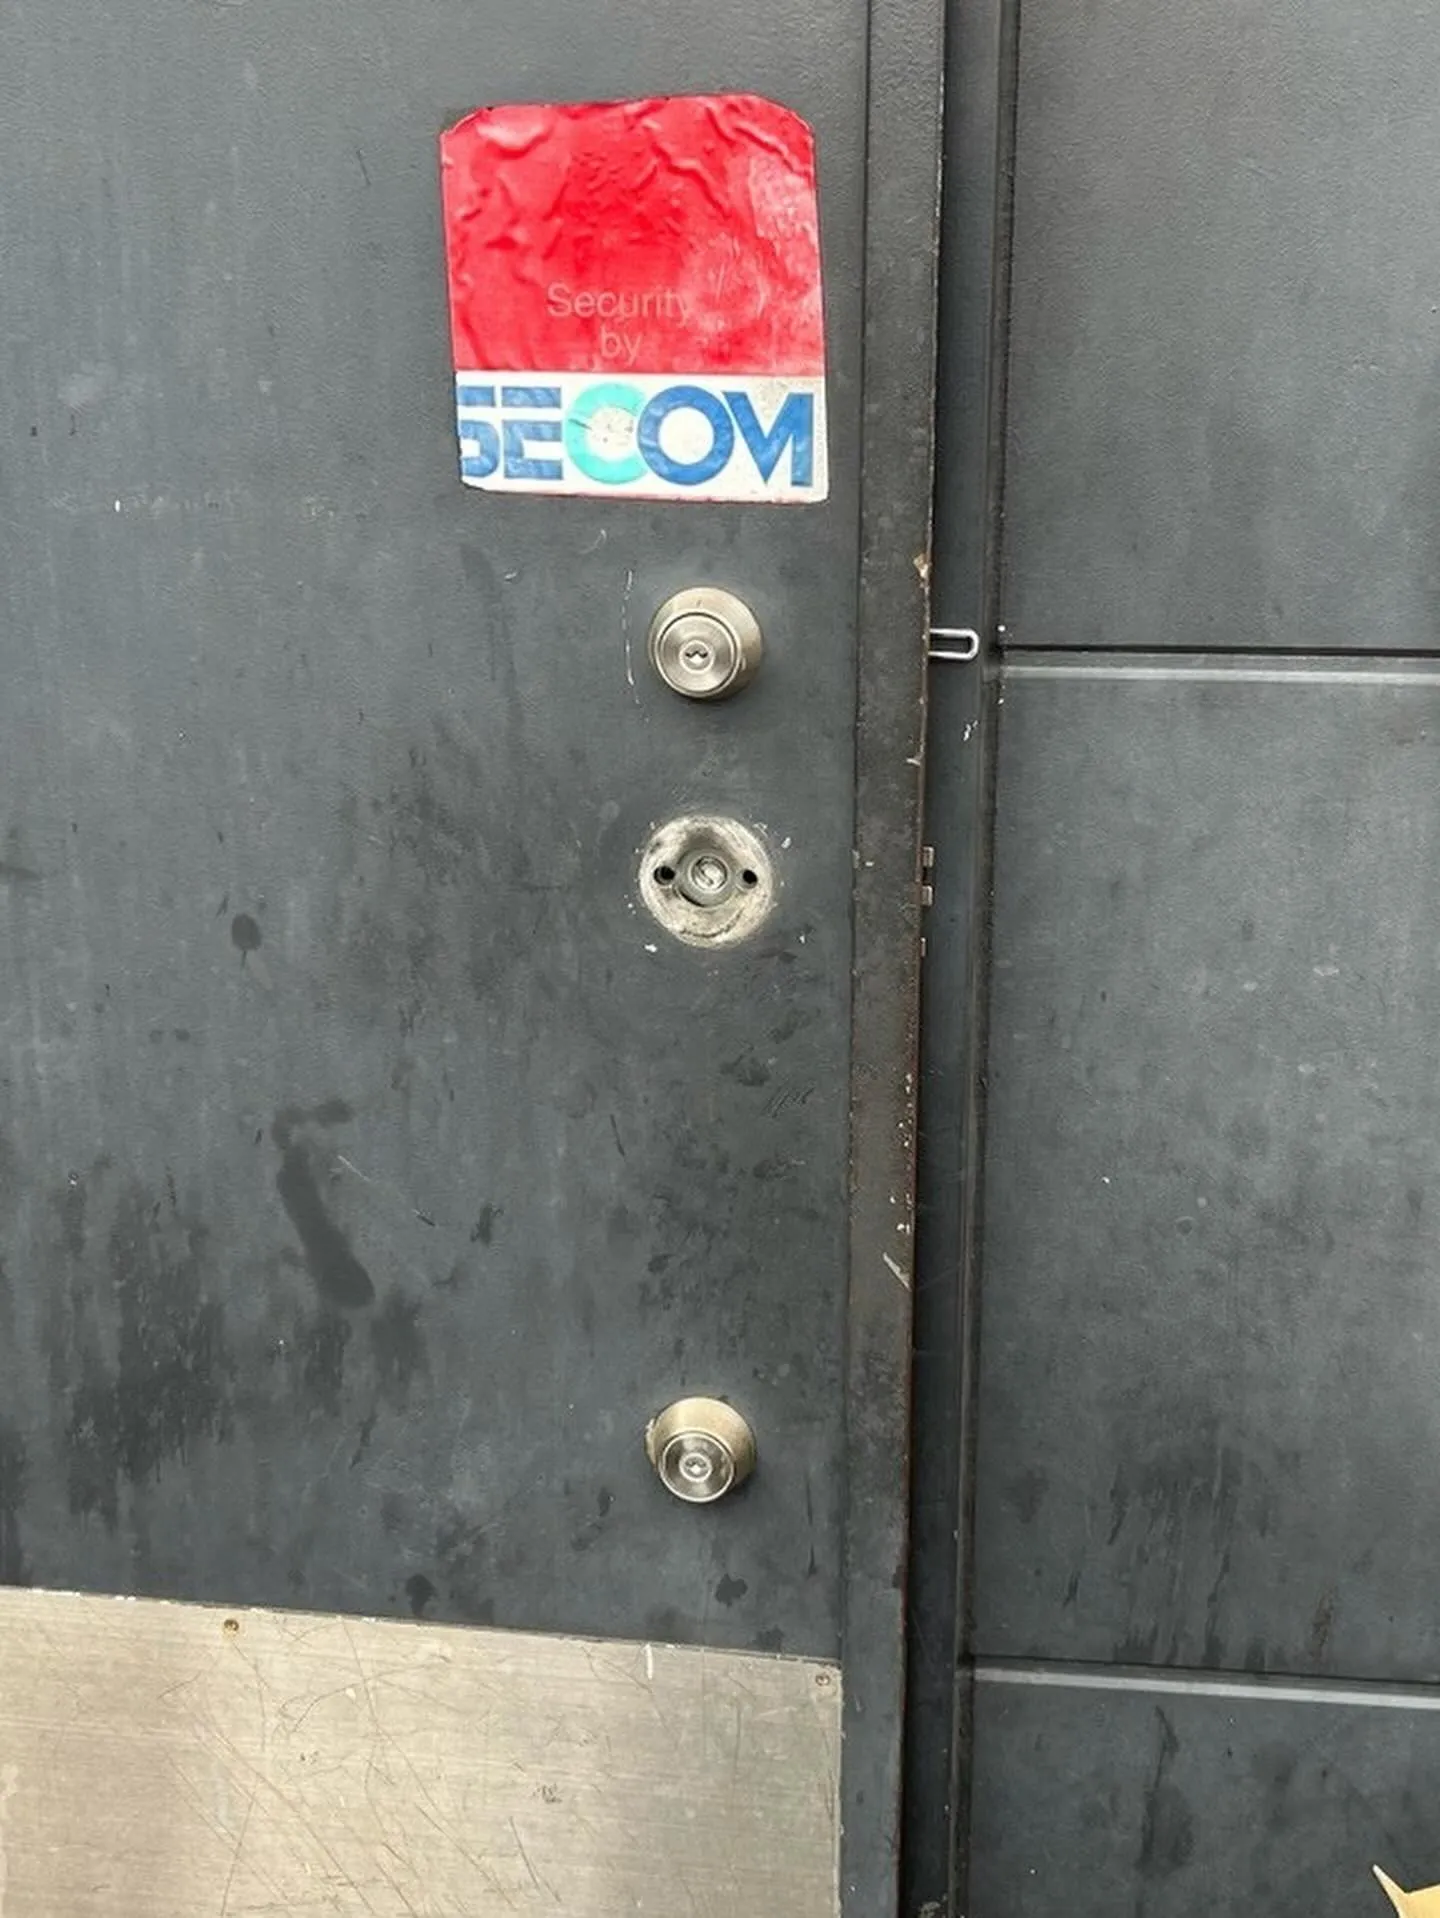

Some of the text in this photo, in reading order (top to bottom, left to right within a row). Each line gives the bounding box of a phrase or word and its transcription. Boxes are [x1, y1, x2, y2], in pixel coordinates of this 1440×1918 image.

[547, 284, 692, 325] Security
[600, 328, 643, 361] by
[458, 383, 813, 487] SECOM
